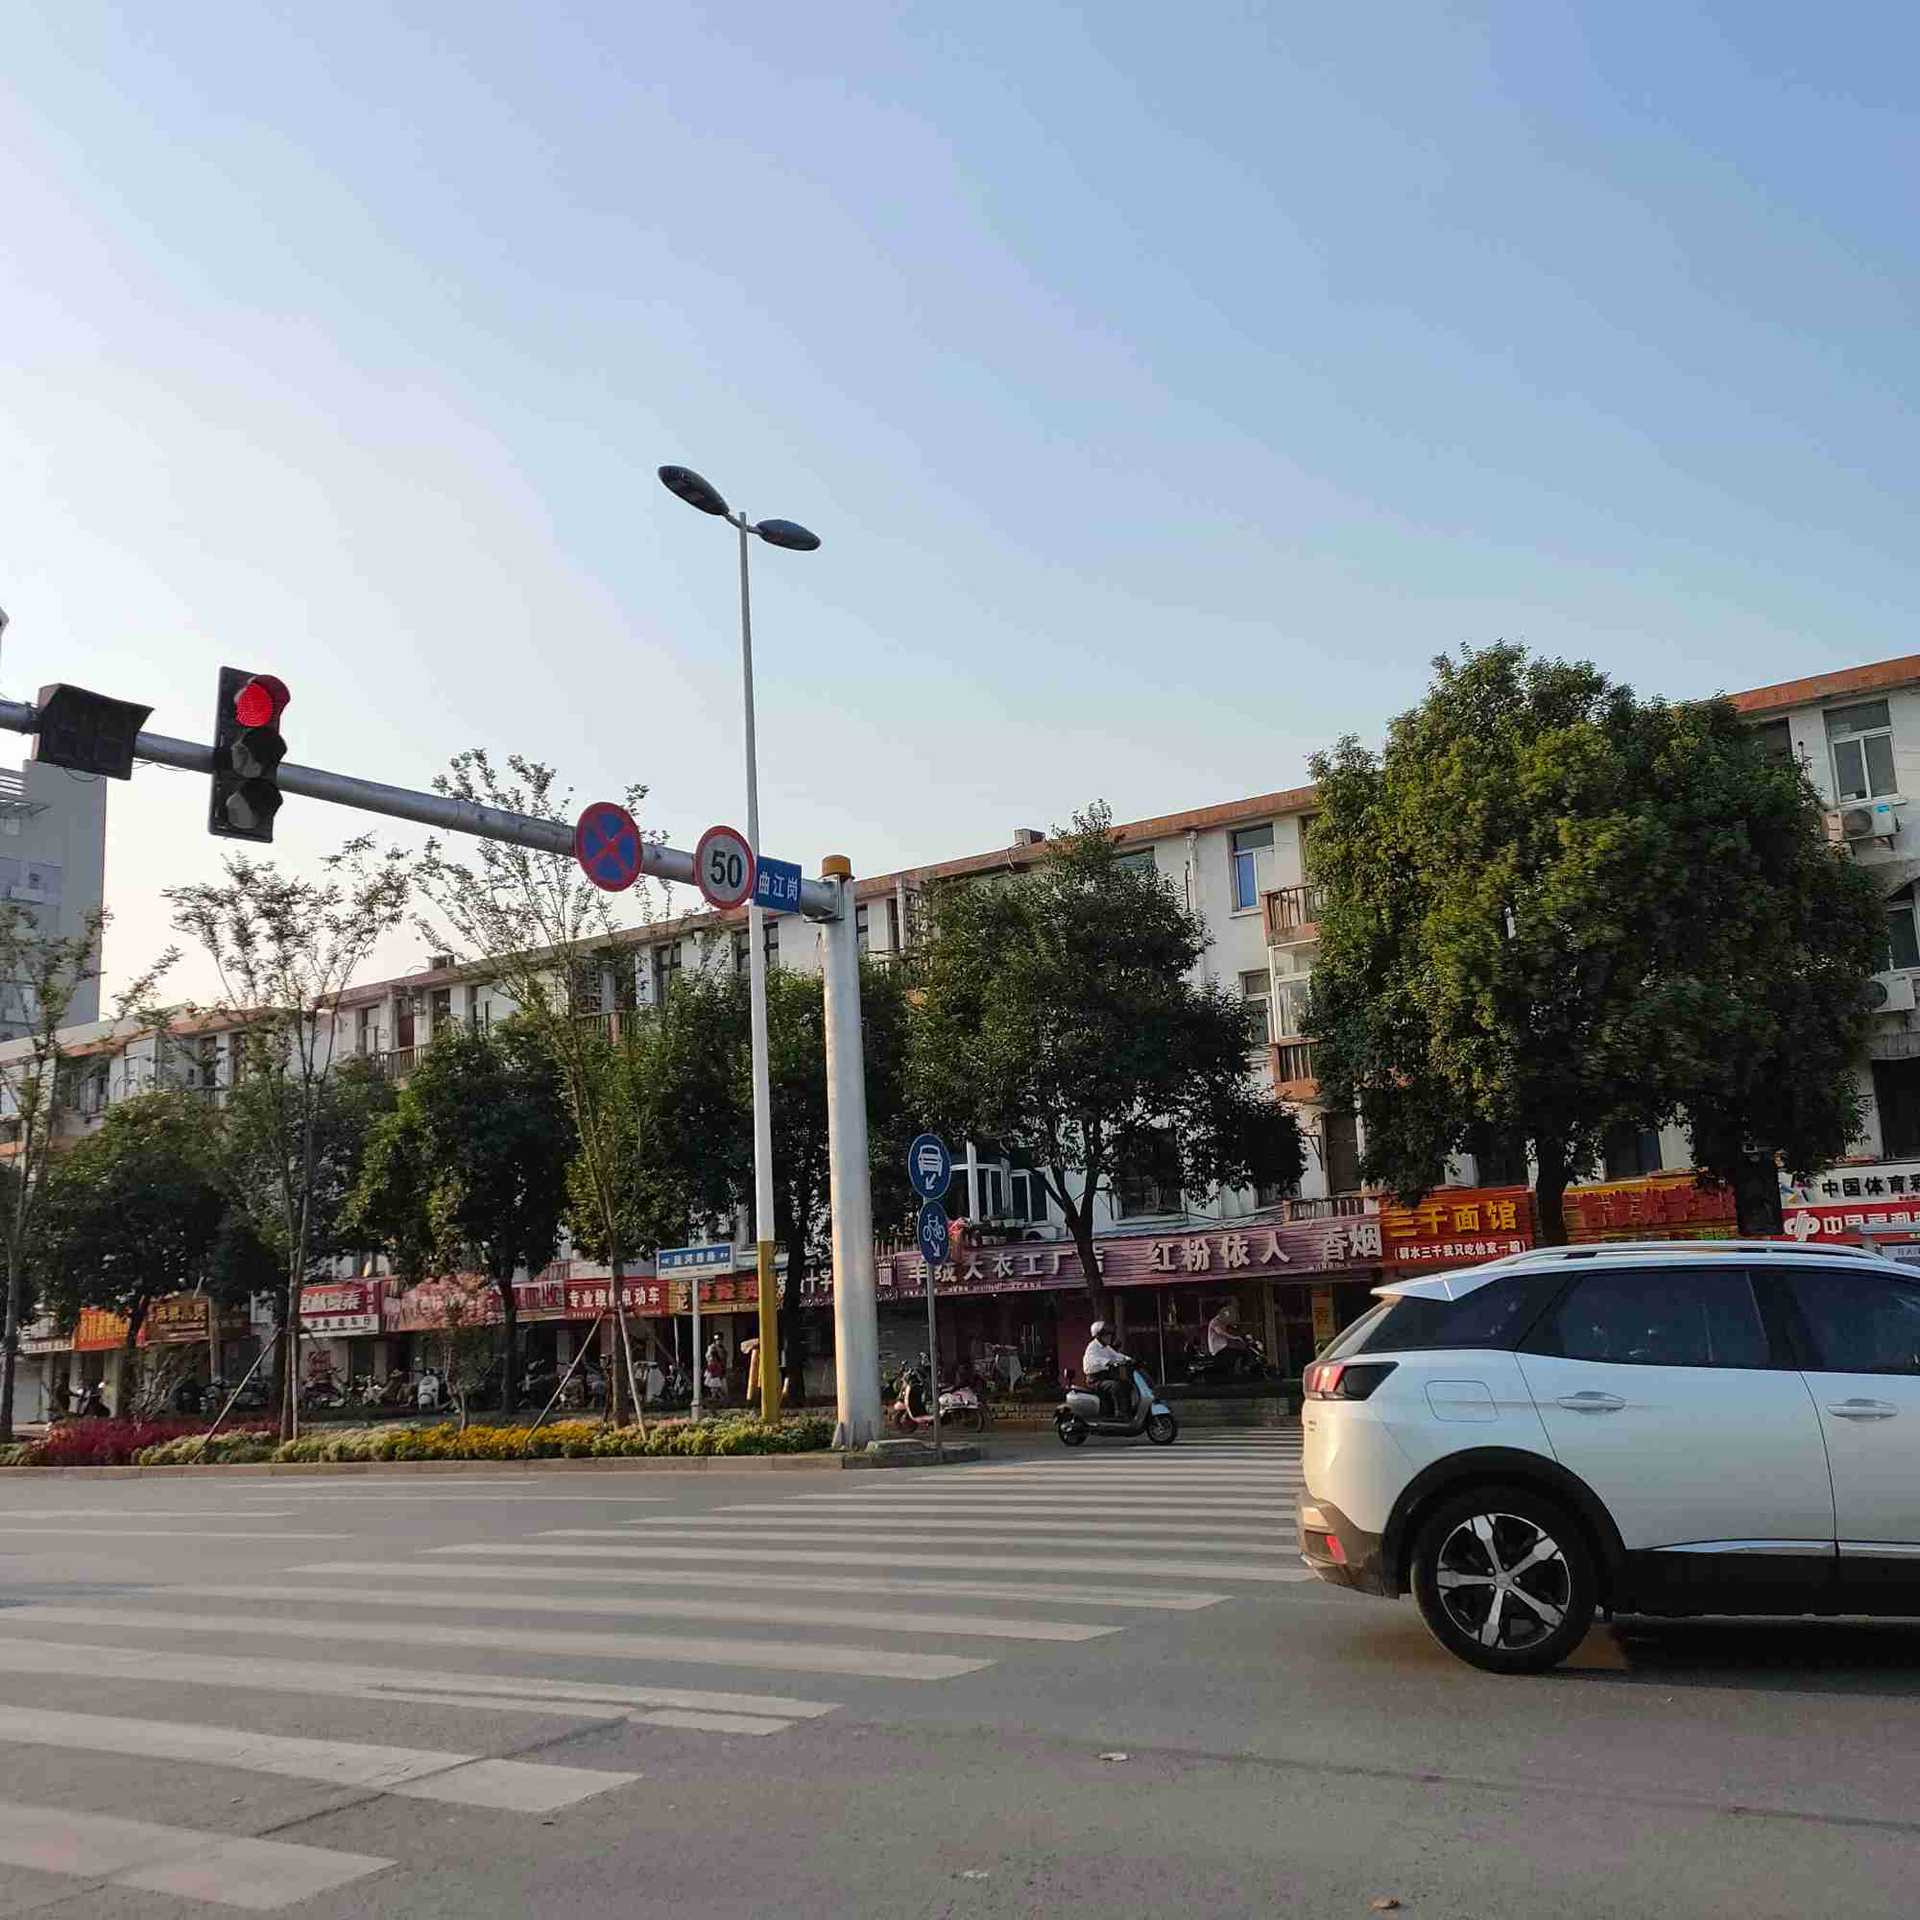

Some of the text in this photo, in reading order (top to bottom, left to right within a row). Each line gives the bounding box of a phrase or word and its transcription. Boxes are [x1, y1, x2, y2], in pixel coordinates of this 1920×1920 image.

[711, 850, 742, 888] 50
[758, 871, 798, 902] 曲江岗
[1388, 1199, 1518, 1237] 三千面馆
[1150, 1222, 1383, 1273] 红粉依人 香烟
[568, 1286, 661, 1309] 专业维电动车
